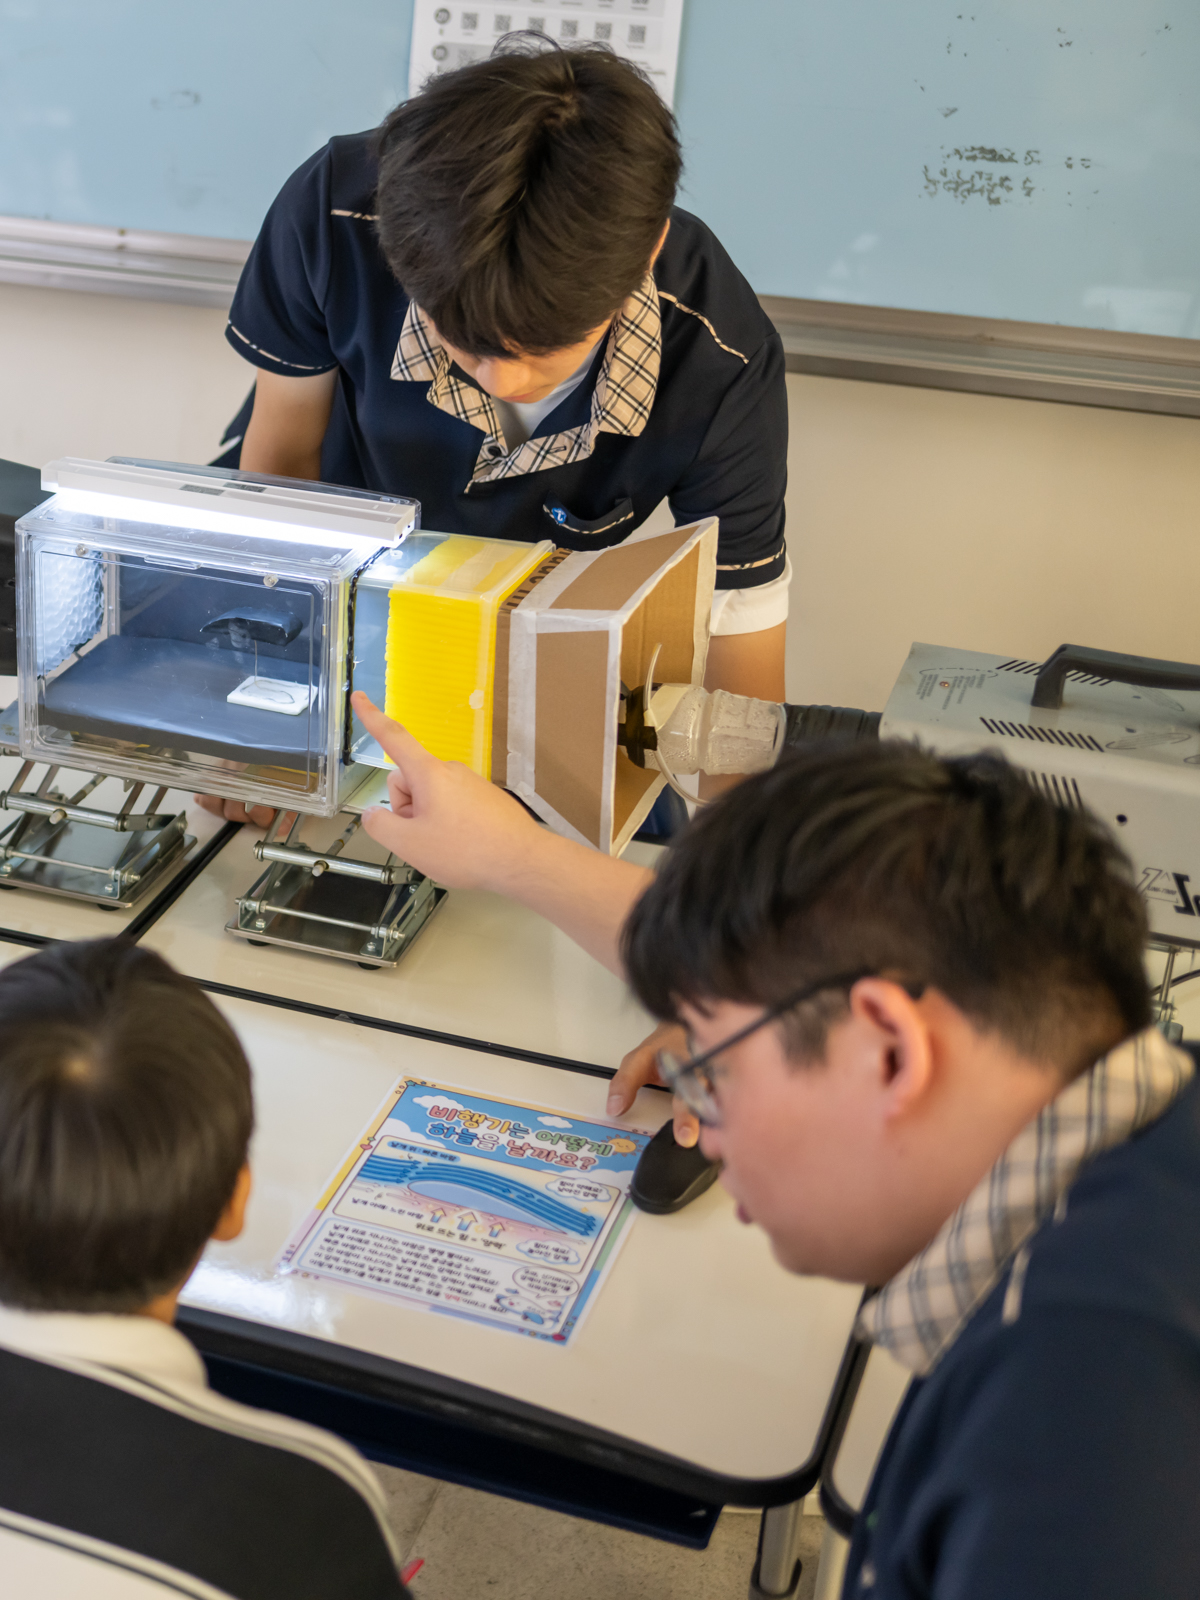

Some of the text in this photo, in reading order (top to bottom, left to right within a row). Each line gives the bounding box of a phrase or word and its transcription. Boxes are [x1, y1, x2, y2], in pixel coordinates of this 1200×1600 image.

[428, 1123, 596, 1169] 하늘을 날까요?
[429, 1105, 613, 1156] 비행기는 어떻게
[390, 1141, 407, 1149] 날개
[439, 1153, 456, 1161] 바람
[415, 1222, 434, 1231] 위로
[437, 1227, 455, 1237] 뜨는
[458, 1233, 468, 1241] 힘
